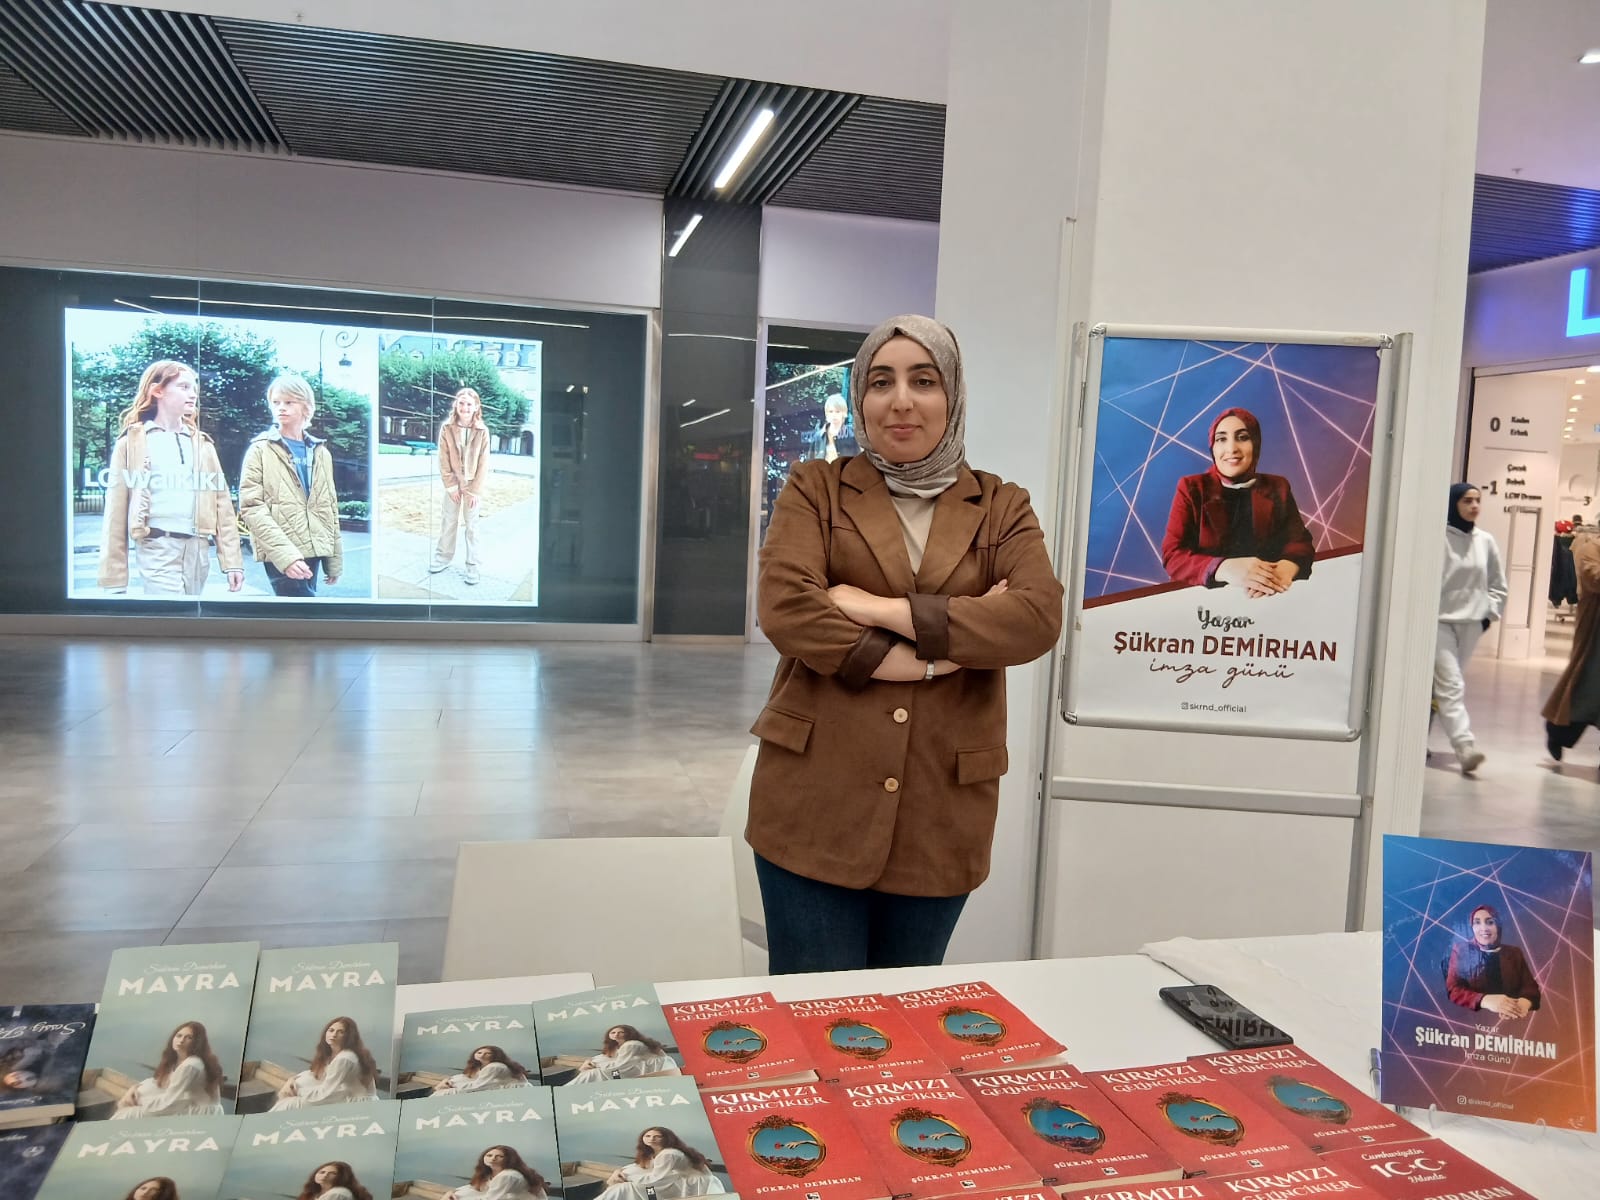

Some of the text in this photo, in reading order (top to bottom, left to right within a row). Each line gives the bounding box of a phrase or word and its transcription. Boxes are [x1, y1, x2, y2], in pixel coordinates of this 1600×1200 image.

[1197, 605, 1255, 632] Yazar
[1113, 631, 1338, 662] Şükran DEMİRHAN
[1149, 658, 1295, 689] imza günü
[118, 971, 240, 996] MAYRA
[269, 969, 386, 993] MAYRA
[547, 997, 650, 1022] MAYRA
[416, 1019, 525, 1036] MAYRA
[1415, 1026, 1557, 1059] Şükran DEMİRHAN
[571, 1093, 691, 1115] MAYRA
[415, 1107, 543, 1130] MAYRA
[252, 1121, 386, 1147] MAYRA
[77, 1136, 219, 1159] MAYRA
[1223, 1166, 1338, 1192] KIRMIZI
